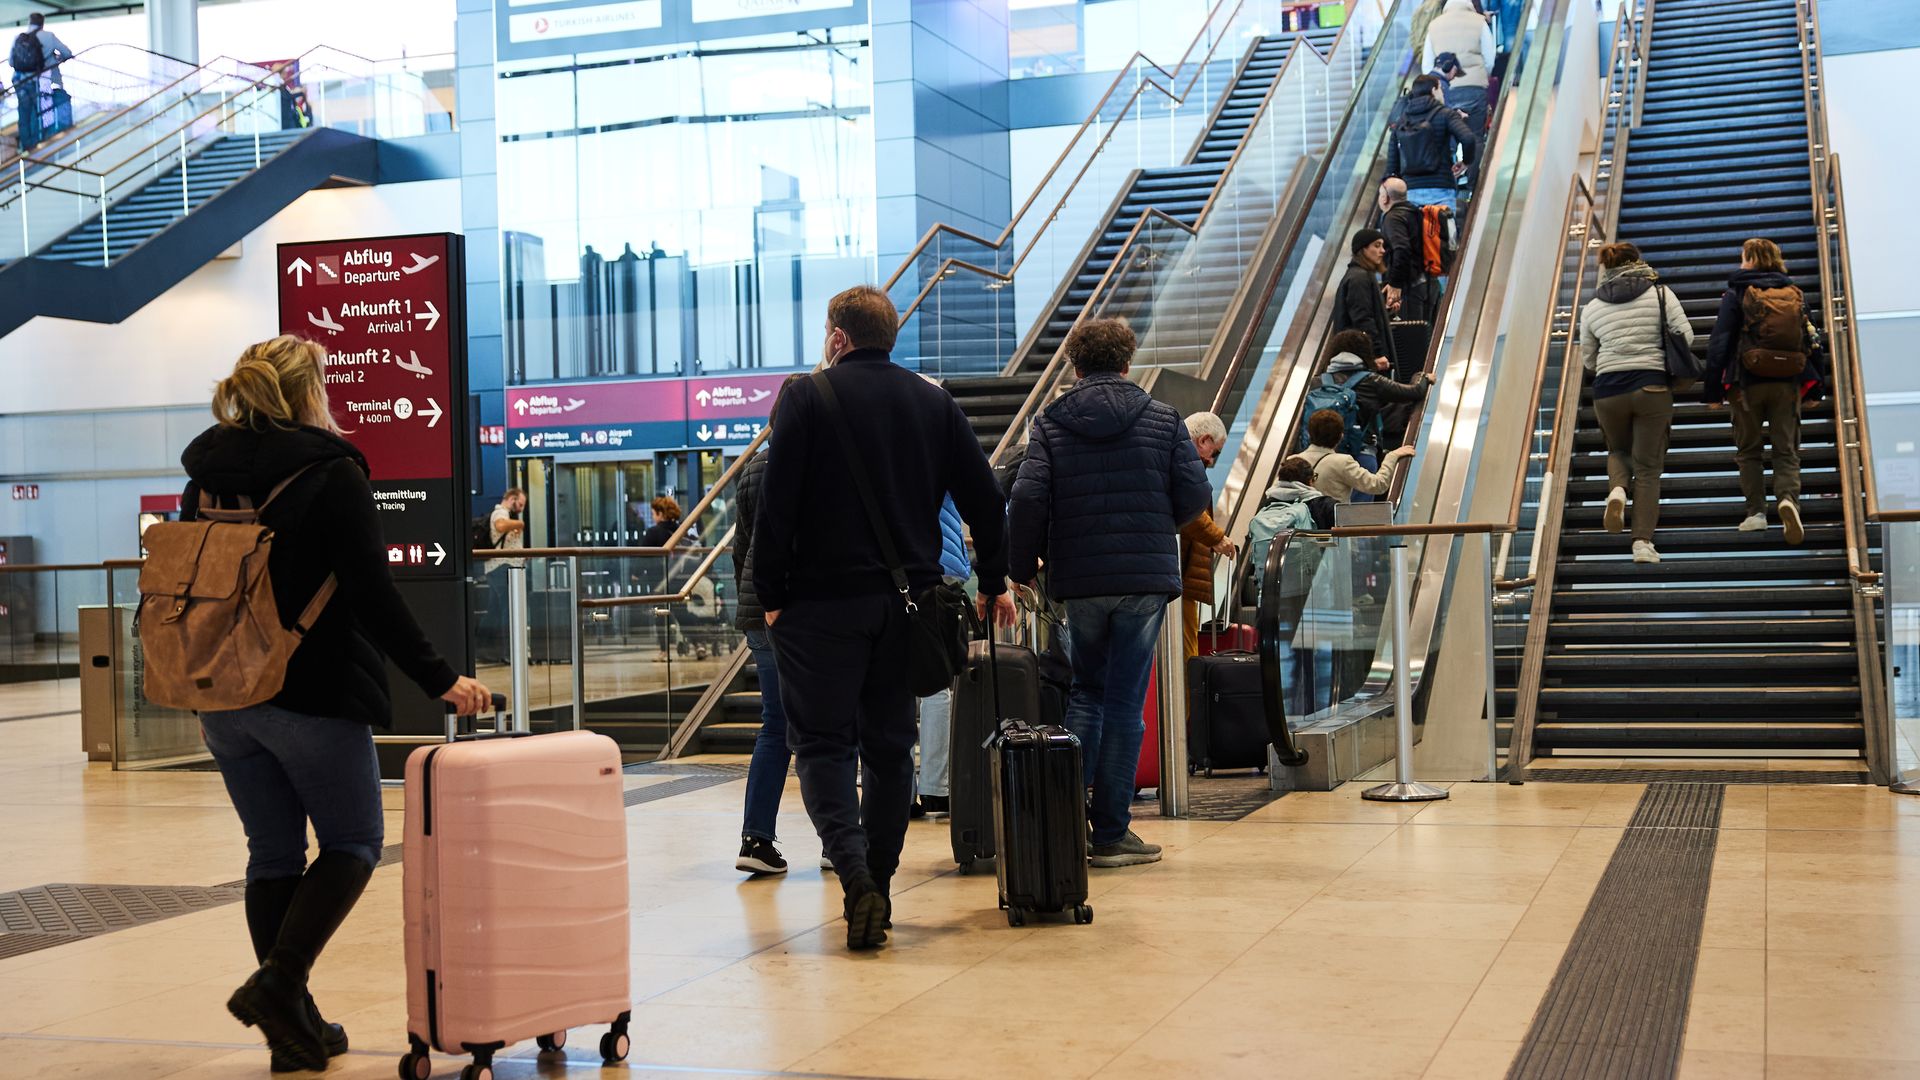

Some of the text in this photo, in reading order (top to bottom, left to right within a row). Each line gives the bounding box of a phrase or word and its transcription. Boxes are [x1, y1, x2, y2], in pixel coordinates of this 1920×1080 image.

[343, 249, 392, 267] Abflug
[344, 270, 401, 286] Departure
[340, 299, 411, 317] Ankunft 1
[367, 319, 412, 334] Arrival 1
[382, 348, 391, 363] 2
[357, 371, 365, 383] 2
[712, 386, 743, 398] Abflug
[346, 399, 410, 413] Terminal T2
[529, 396, 558, 407] Abflug
[712, 397, 747, 407] Departure
[529, 406, 563, 416] Departure
[366, 414, 382, 423] 400
[609, 428, 633, 438] Airport
[609, 437, 623, 446] City
[373, 489, 427, 501] ckermittlung
[382, 502, 406, 511] Tracing
